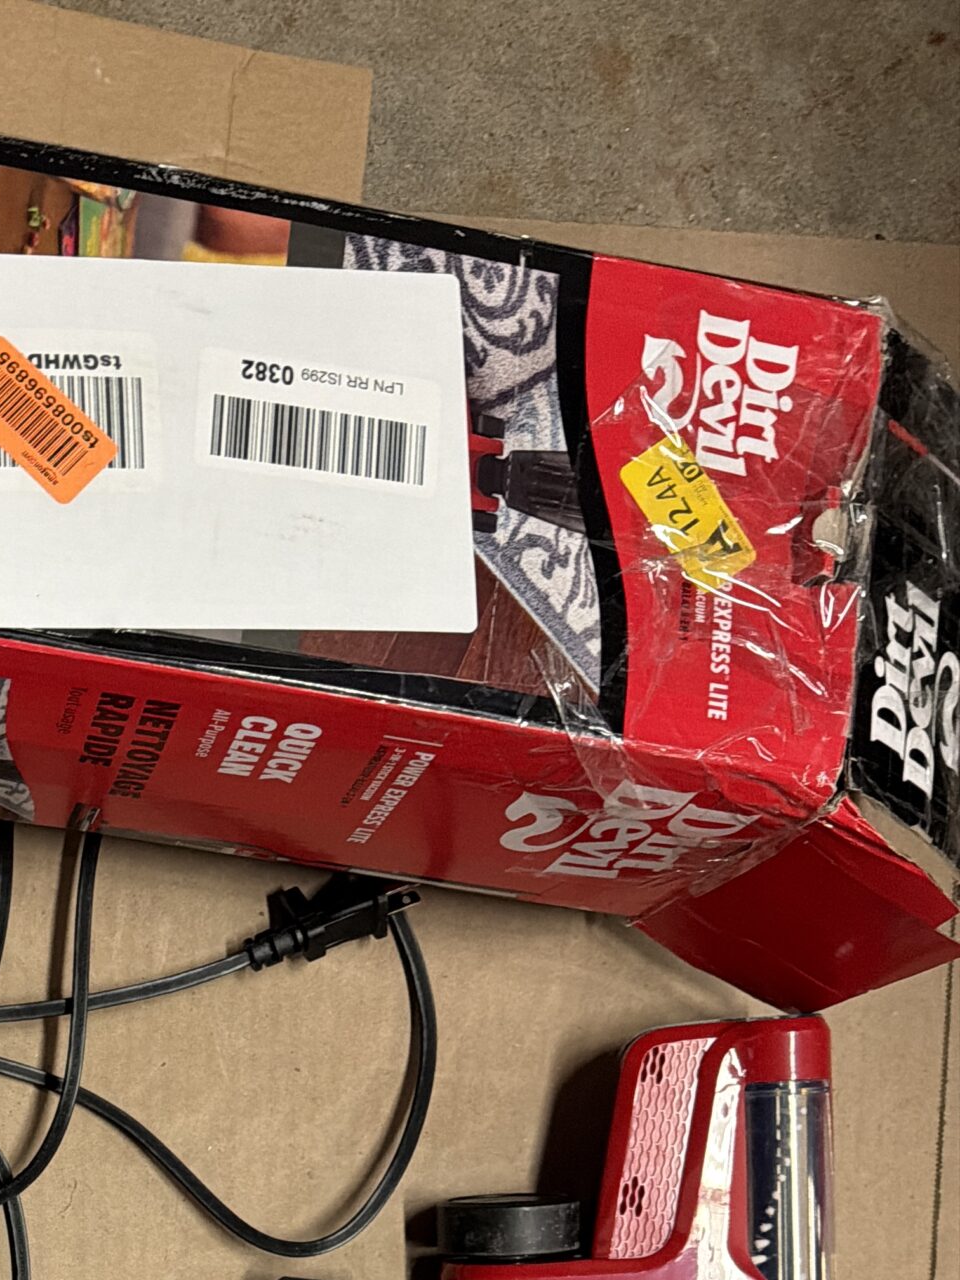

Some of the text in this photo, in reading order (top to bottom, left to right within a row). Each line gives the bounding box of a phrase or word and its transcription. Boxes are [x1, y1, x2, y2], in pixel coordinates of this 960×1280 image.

[239, 358, 403, 395] LPN RR IS299 0382
[695, 309, 751, 477] Devil
[736, 336, 799, 464] Dirt
[694, 589, 706, 623] ACUUM
[707, 682, 729, 721] LITE
[870, 592, 913, 760] Dirt
[902, 580, 940, 800] Devil
[79, 691, 136, 768] RAPIDE
[108, 698, 182, 800] NETTOYAGE
[196, 708, 231, 758] All-Purpose
[217, 715, 278, 777] CLEAN
[258, 722, 323, 784] QUICK
[392, 751, 436, 787] POWER
[346, 828, 376, 844] LITE
[541, 778, 699, 879] Devil
[613, 803, 763, 873] Dirt
